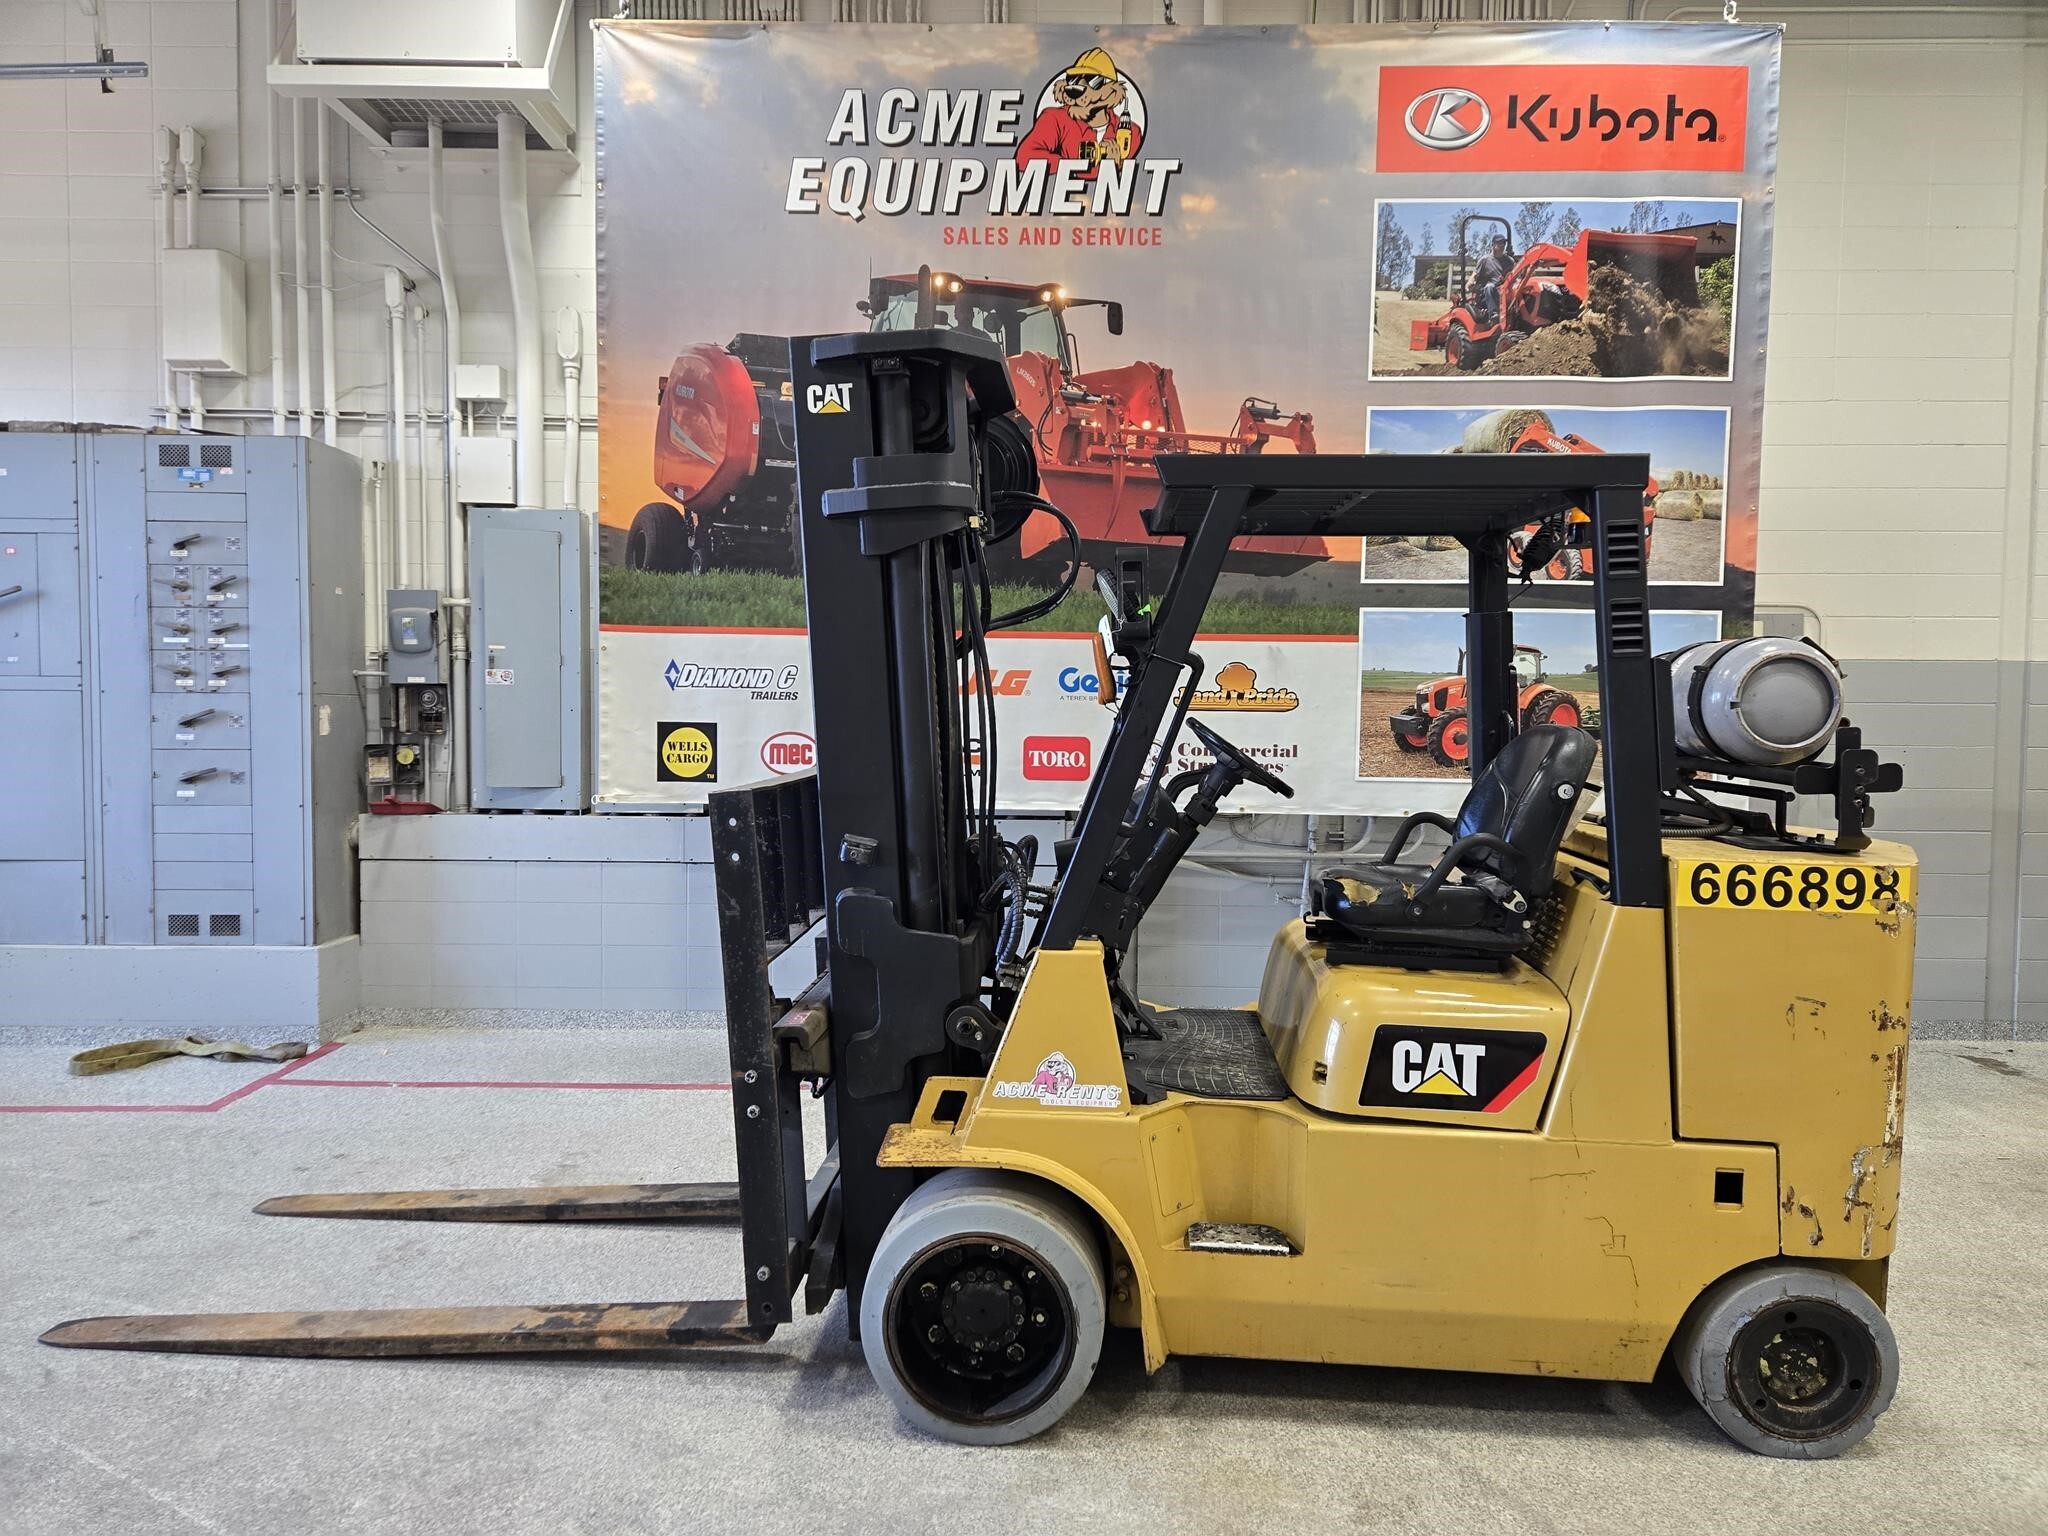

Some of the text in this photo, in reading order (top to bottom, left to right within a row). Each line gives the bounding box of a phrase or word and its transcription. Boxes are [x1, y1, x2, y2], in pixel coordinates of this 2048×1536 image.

[826, 88, 1022, 146] ACME
[1507, 93, 1718, 142] Kubota
[785, 156, 1183, 222] EQUIPMENT
[943, 226, 1162, 247] SALES AND SERVICE
[806, 382, 853, 414] CAT
[677, 664, 799, 690] DIAMOND C
[750, 691, 799, 701] TRAILERS
[1242, 688, 1298, 706] Pride
[668, 741, 708, 752] WELLS
[666, 753, 709, 765] CARGO
[1029, 750, 1087, 768] TORO
[1690, 862, 1900, 912] 666898
[1391, 1039, 1486, 1097] CAT
[994, 1081, 1120, 1101] ACME RENTS
